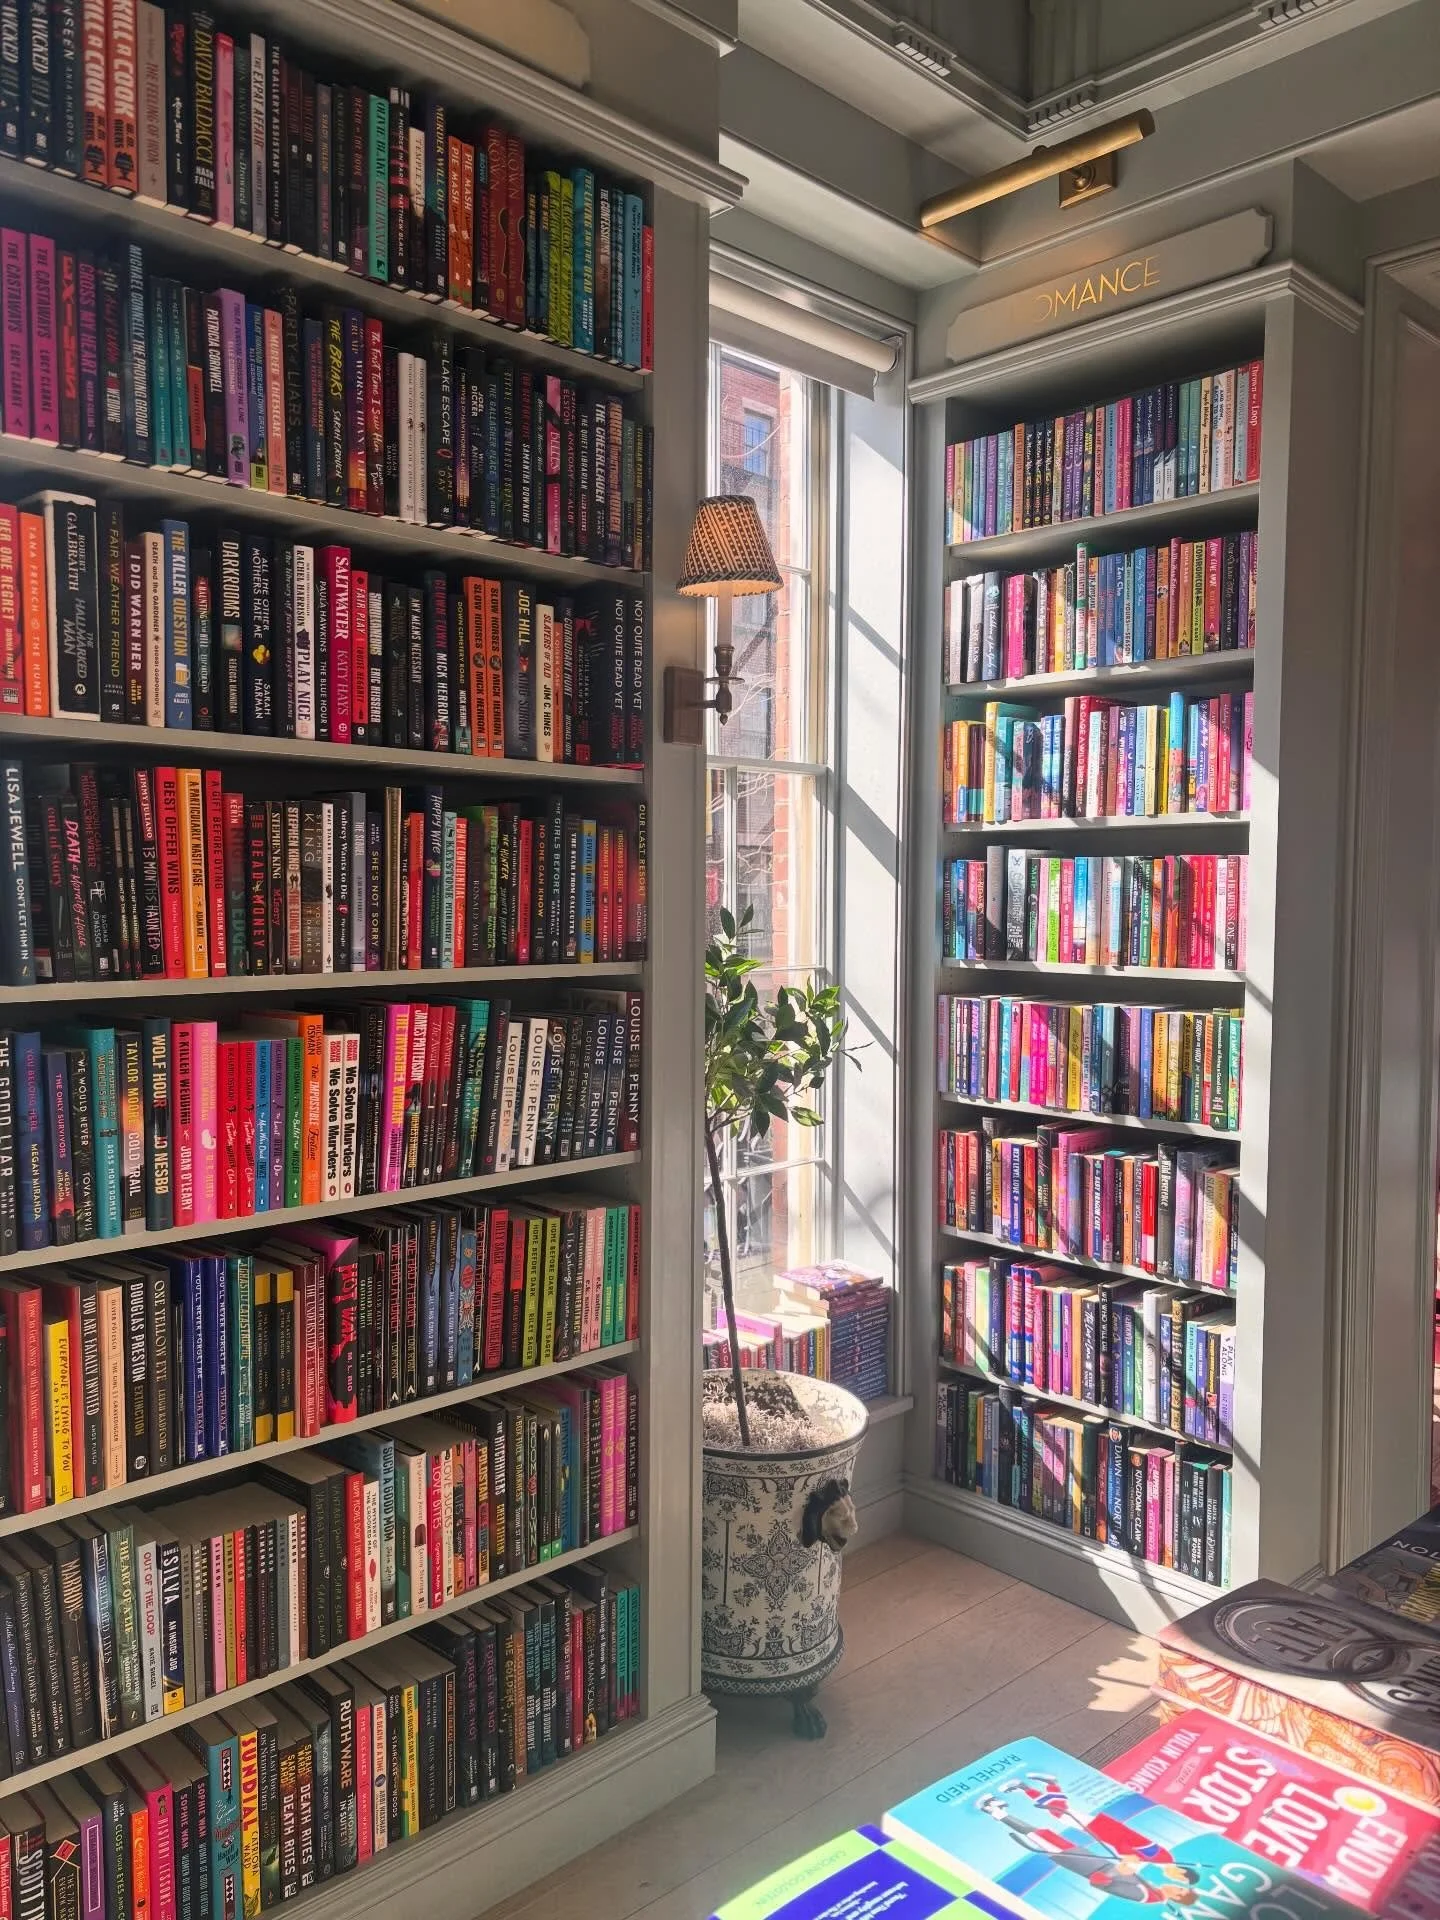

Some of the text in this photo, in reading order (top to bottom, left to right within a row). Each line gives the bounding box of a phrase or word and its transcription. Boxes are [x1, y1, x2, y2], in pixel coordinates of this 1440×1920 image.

[114, 59, 135, 118] COOK
[195, 27, 214, 163] DAVID BALDACCI
[253, 71, 265, 108] EXPAT
[272, 45, 281, 175] THE GALLERY ASSISTANT
[253, 110, 265, 149] AFFAIR
[195, 167, 215, 190] NASH FALLS
[37, 272, 51, 339] CASTAWAYS
[1036, 254, 1160, 322] OMANCE
[130, 245, 149, 438] MICHAEL CONNELLY THE PROVING GROUND
[207, 309, 219, 349] PATRICIA
[210, 352, 222, 393] CORNWELL
[328, 320, 343, 478] THE BRIARS SARAH CROUCH
[441, 361, 449, 392] LAKE
[441, 396, 450, 444] ESCAPE
[596, 404, 605, 503] THE CHEERLEADER
[67, 513, 79, 590] GALBRAITH
[130, 563, 141, 588] DID
[172, 531, 188, 656] THE KILLER QUESTION
[222, 541, 239, 618] DARKROOMS
[64, 619, 76, 654] MAN
[75, 598, 88, 678] HALLMARKED
[131, 594, 142, 642] WARN
[336, 555, 349, 715] SALTWATER KATY HAYS
[518, 589, 530, 645] JOE HILL
[634, 628, 643, 660] QUITE
[131, 644, 142, 670] HER
[635, 661, 643, 689] DEAD
[255, 678, 263, 718] HARMAN
[437, 653, 448, 721] MICK HERRON
[635, 692, 643, 710] YET
[1080, 713, 1088, 734] CAGE
[1077, 767, 1086, 784] BIRD
[5, 767, 29, 960] LISA JEWELL LET HIM IN
[164, 781, 179, 895] BEST OFFER WINS
[371, 885, 380, 908] NOT
[371, 911, 380, 946] SORRY
[127, 1042, 139, 1083] TAYLOR
[152, 1034, 166, 1075] WOLF
[411, 1010, 427, 1081] JAMES PATTERSON
[628, 998, 641, 1123] LOUISE PENNY
[0, 1037, 14, 1176] THE GOOD LIAR
[128, 1087, 140, 1123] MOORE
[154, 1078, 167, 1109] HOUR
[327, 1067, 341, 1180] We Solve Murders
[130, 1164, 141, 1197] TRAIL
[547, 1223, 558, 1296] HOME BEFORE DARK
[1102, 1291, 1107, 1303] WE
[83, 1296, 100, 1416] YOU ARE FATALLY INVITED
[130, 1282, 146, 1436] DOUGLAS PRESTON EXTINCTION
[383, 1448, 393, 1475] SUCH
[1113, 1445, 1121, 1529] DAWN NORTH
[383, 1489, 393, 1515] GOOD
[383, 1520, 393, 1541] MOM
[143, 1552, 155, 1635] OUT OF THE LOOP
[163, 1556, 180, 1605] SILVA
[167, 1620, 174, 1632] AN
[168, 1635, 176, 1656] INSIDE
[341, 1700, 352, 1789] RUTH WARE
[1125, 1729, 1200, 1794] YULIN KUANG
[242, 1738, 258, 1831] SUNDIAL
[936, 1753, 1021, 1804] RACHEL REID
[1183, 1746, 1279, 1836] STOR
[301, 1784, 313, 1865] DEATH RITES
[1241, 1782, 1338, 1870] LOVE
[19, 1849, 45, 1903] SCOTT
[157, 1818, 171, 1906] HISTORY LESSONS
[244, 1843, 252, 1869] WARD
